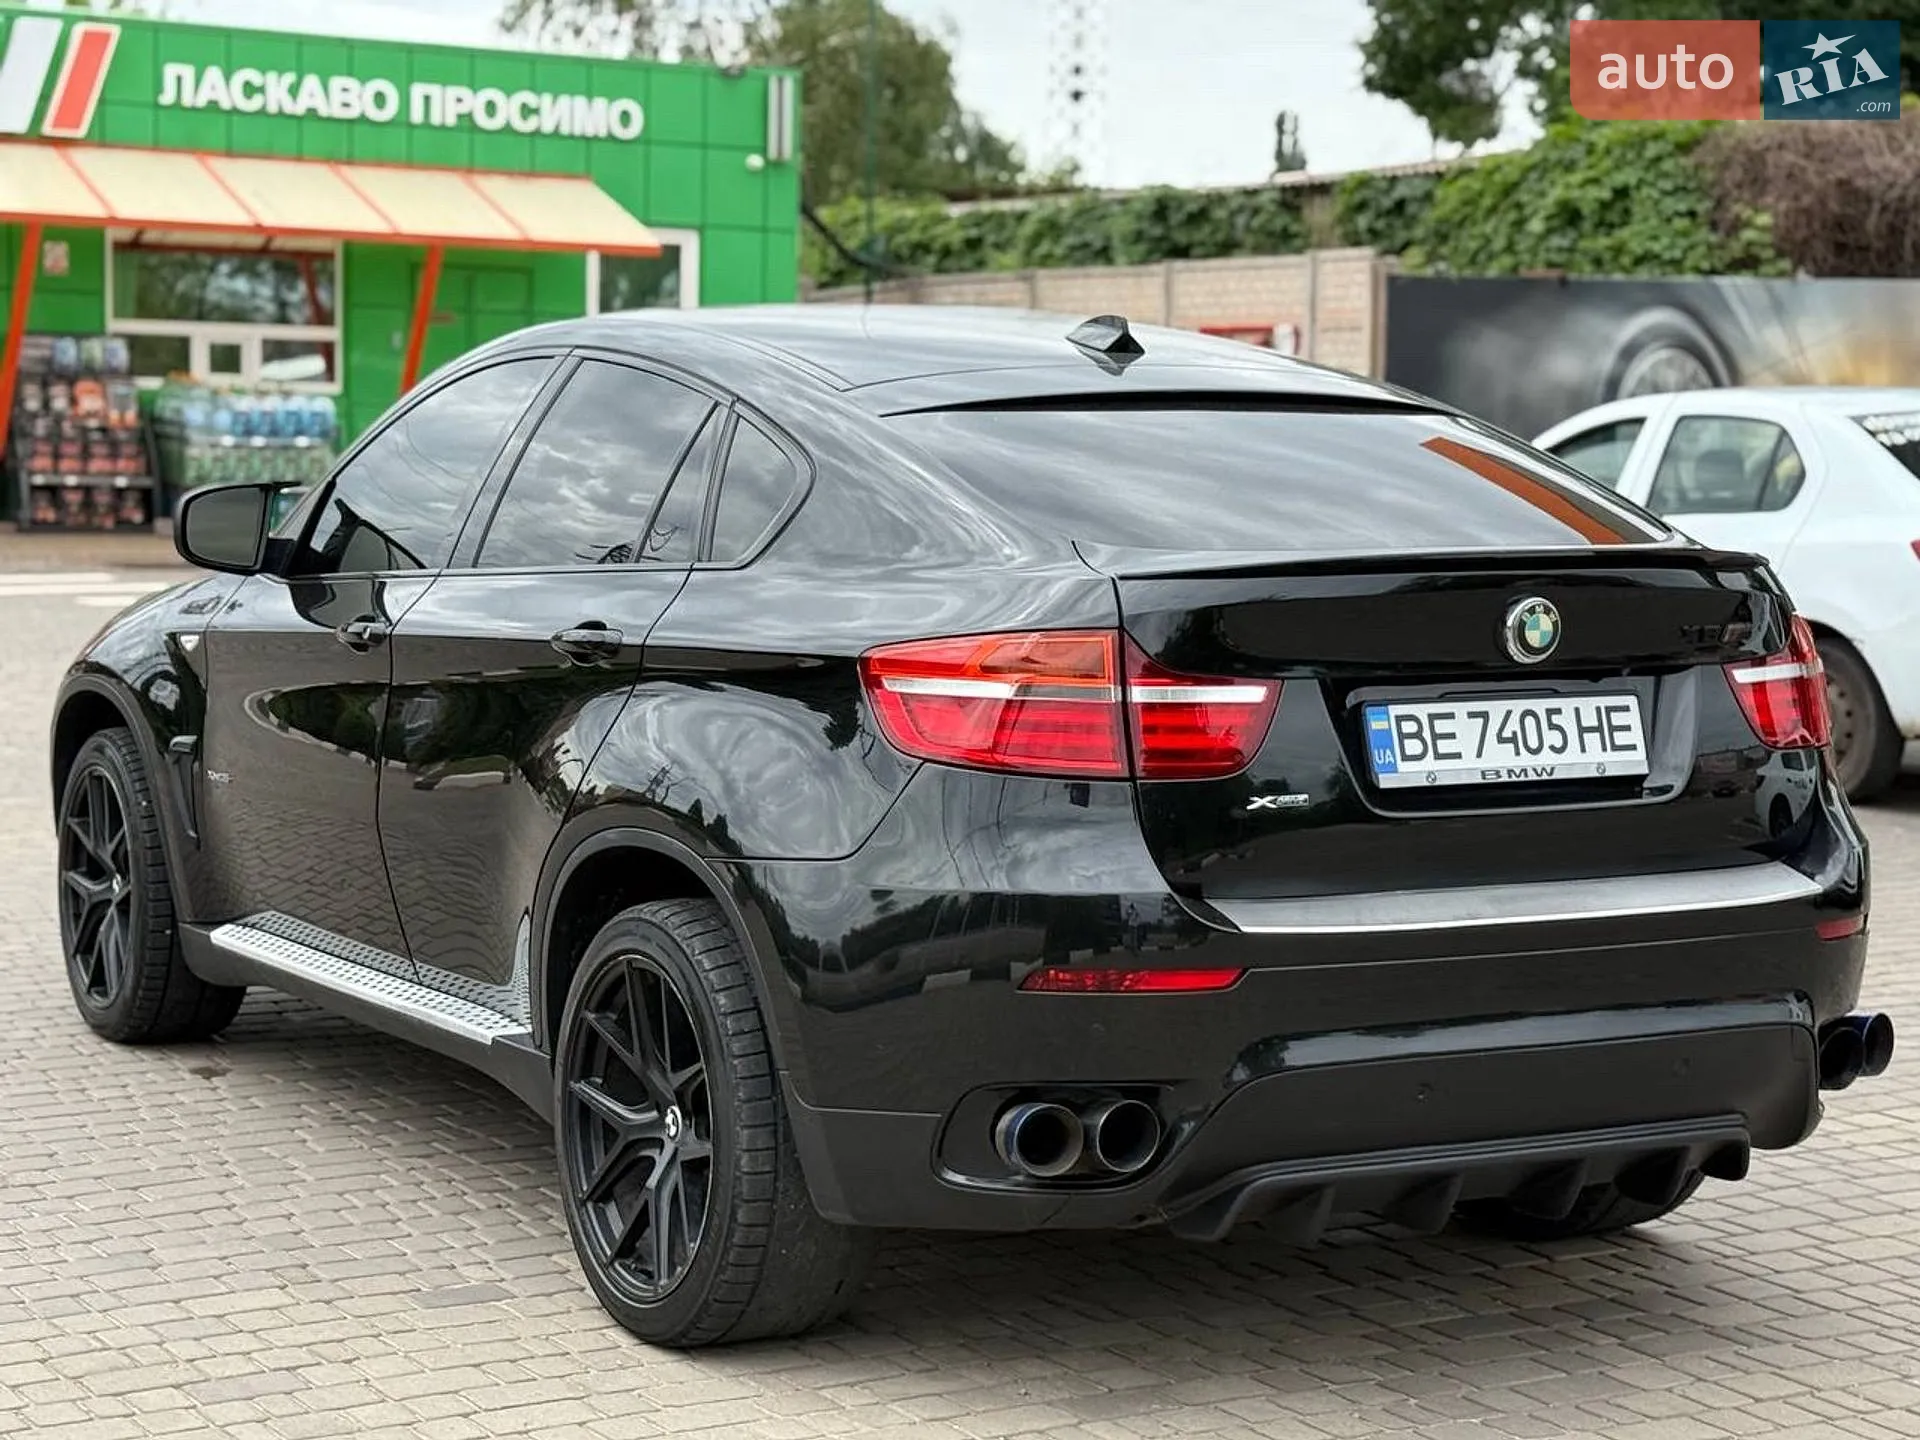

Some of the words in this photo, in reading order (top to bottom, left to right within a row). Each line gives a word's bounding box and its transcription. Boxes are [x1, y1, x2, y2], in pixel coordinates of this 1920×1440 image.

[158, 61, 400, 123] ЛАСКАВО
[409, 81, 645, 141] ПРОСИМО
[1466, 708, 1570, 759] 7405
[1374, 750, 1395, 765] UA
[1480, 766, 1556, 781] BMW
